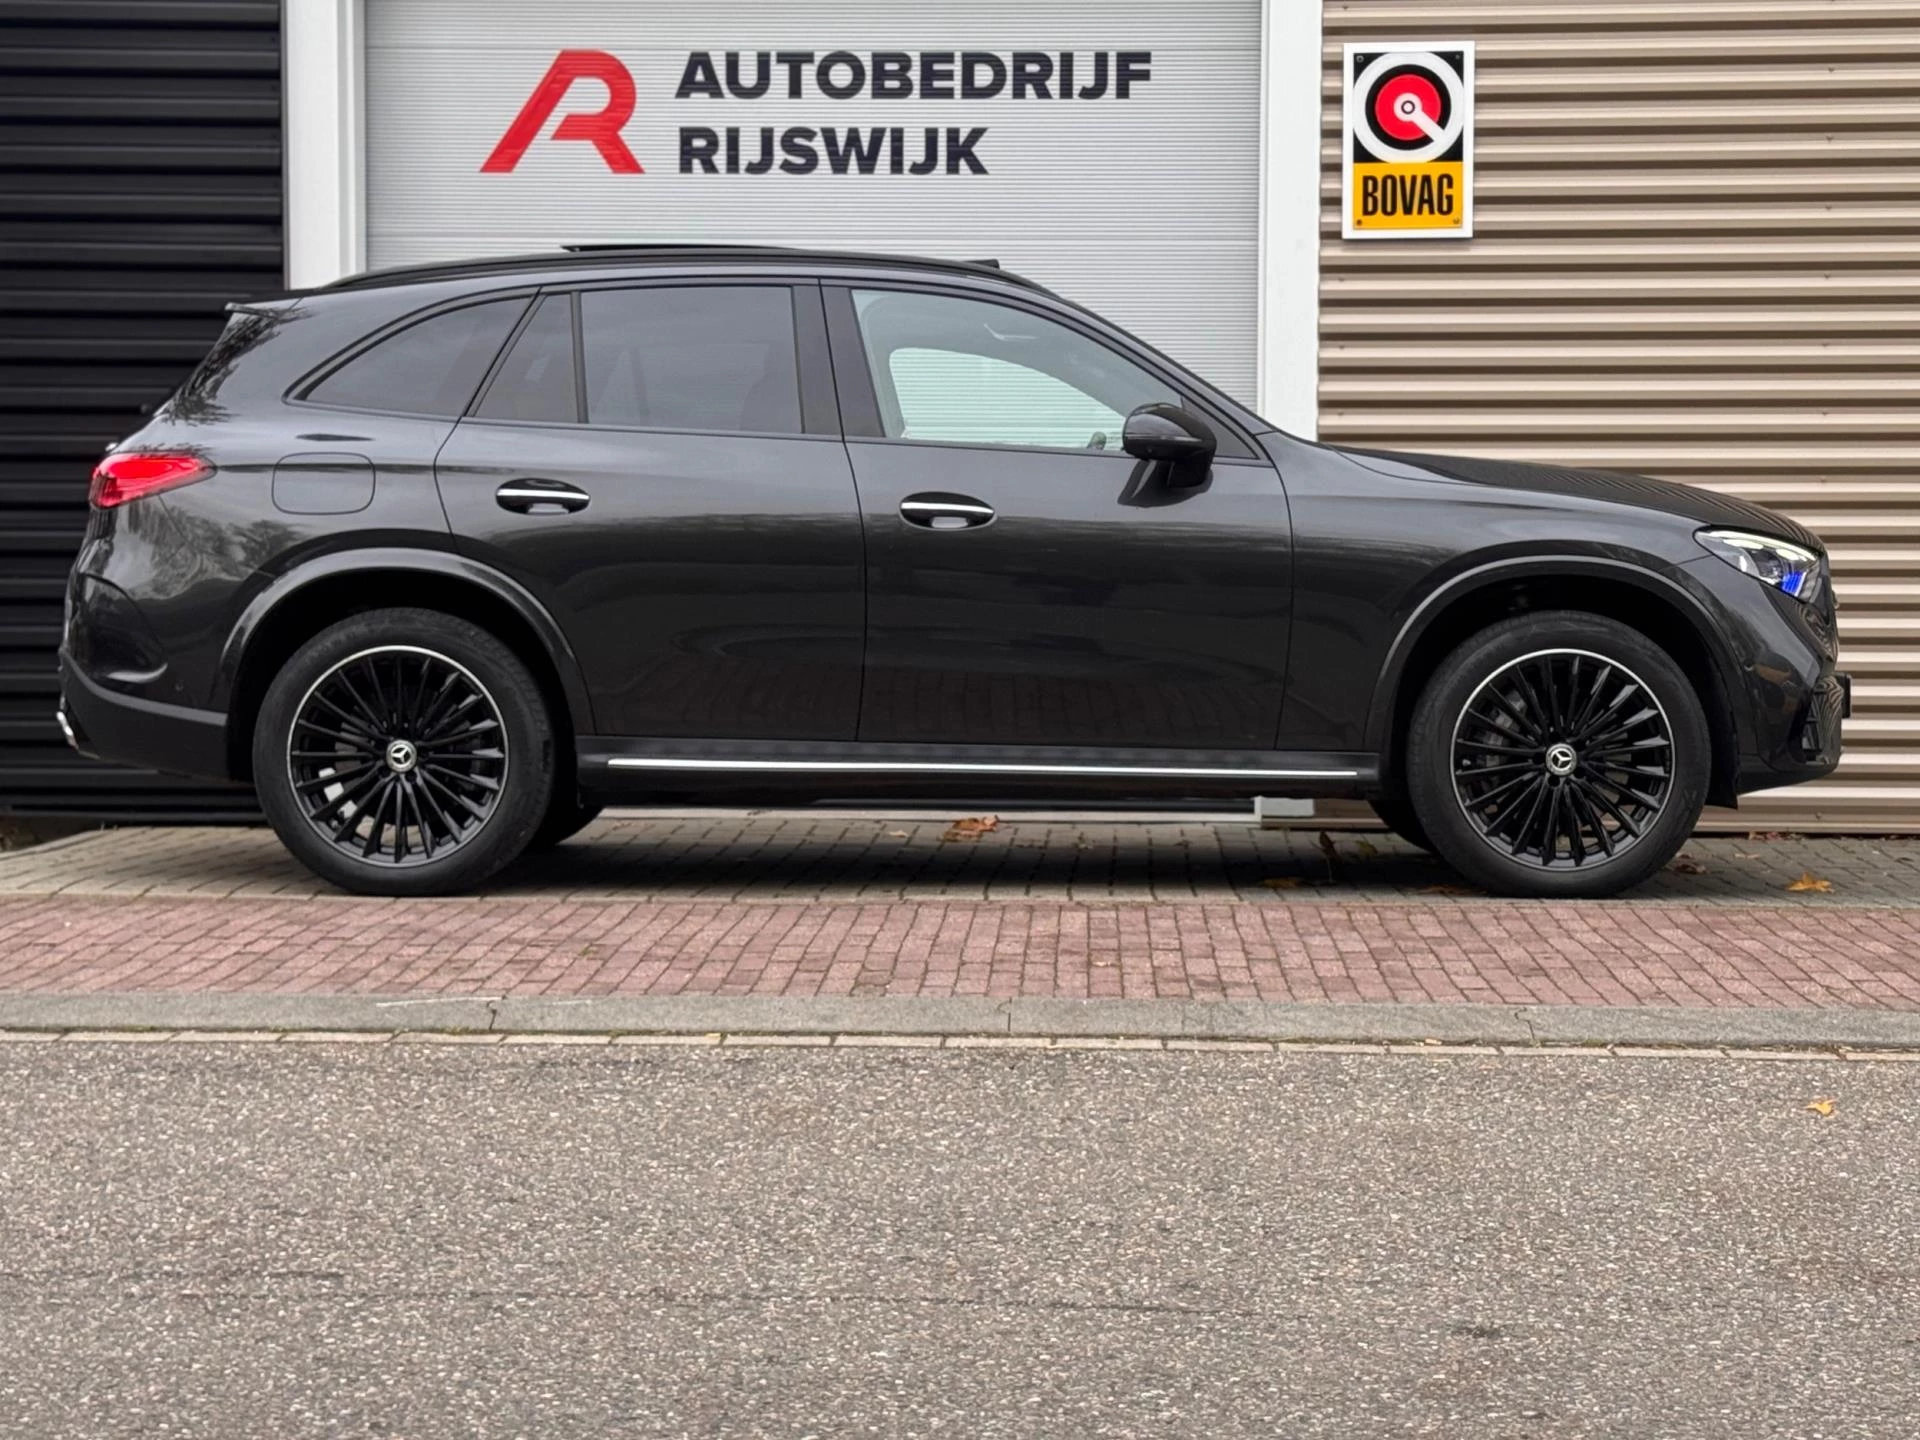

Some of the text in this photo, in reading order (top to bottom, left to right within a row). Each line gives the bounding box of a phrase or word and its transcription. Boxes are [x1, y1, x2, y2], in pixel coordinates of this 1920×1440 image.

[676, 50, 1152, 99] AUTOBEDRIJF
[678, 126, 989, 175] RIJSWIJK
[1362, 174, 1454, 216] BOVAG
